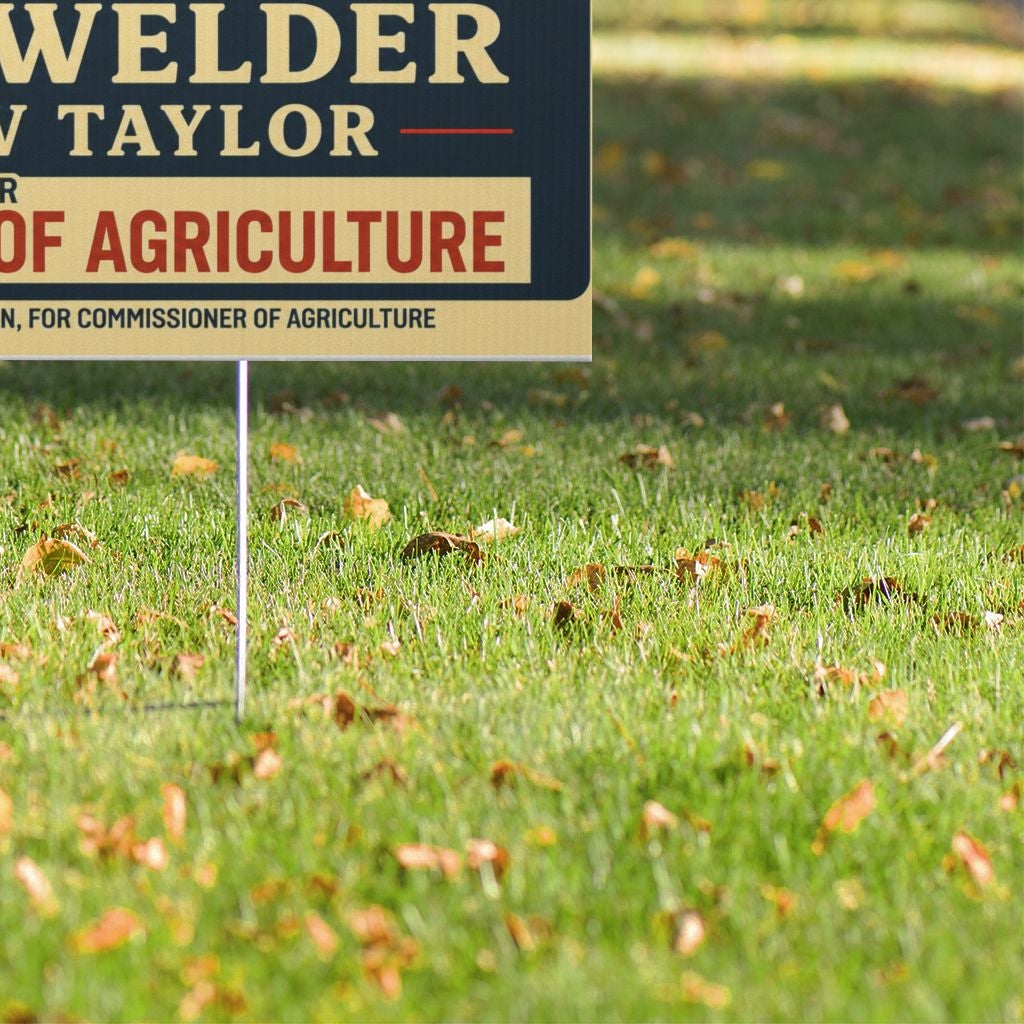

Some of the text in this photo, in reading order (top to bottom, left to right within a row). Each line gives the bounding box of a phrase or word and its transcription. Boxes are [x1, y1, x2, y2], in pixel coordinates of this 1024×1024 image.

[59, 105, 379, 158] TAYLOR
[88, 211, 505, 274] AGRICULTURE
[30, 309, 71, 329] FOR
[79, 309, 247, 329] COMMISSIONER
[255, 309, 281, 329] OF
[288, 309, 436, 329] AGRICULTURE
